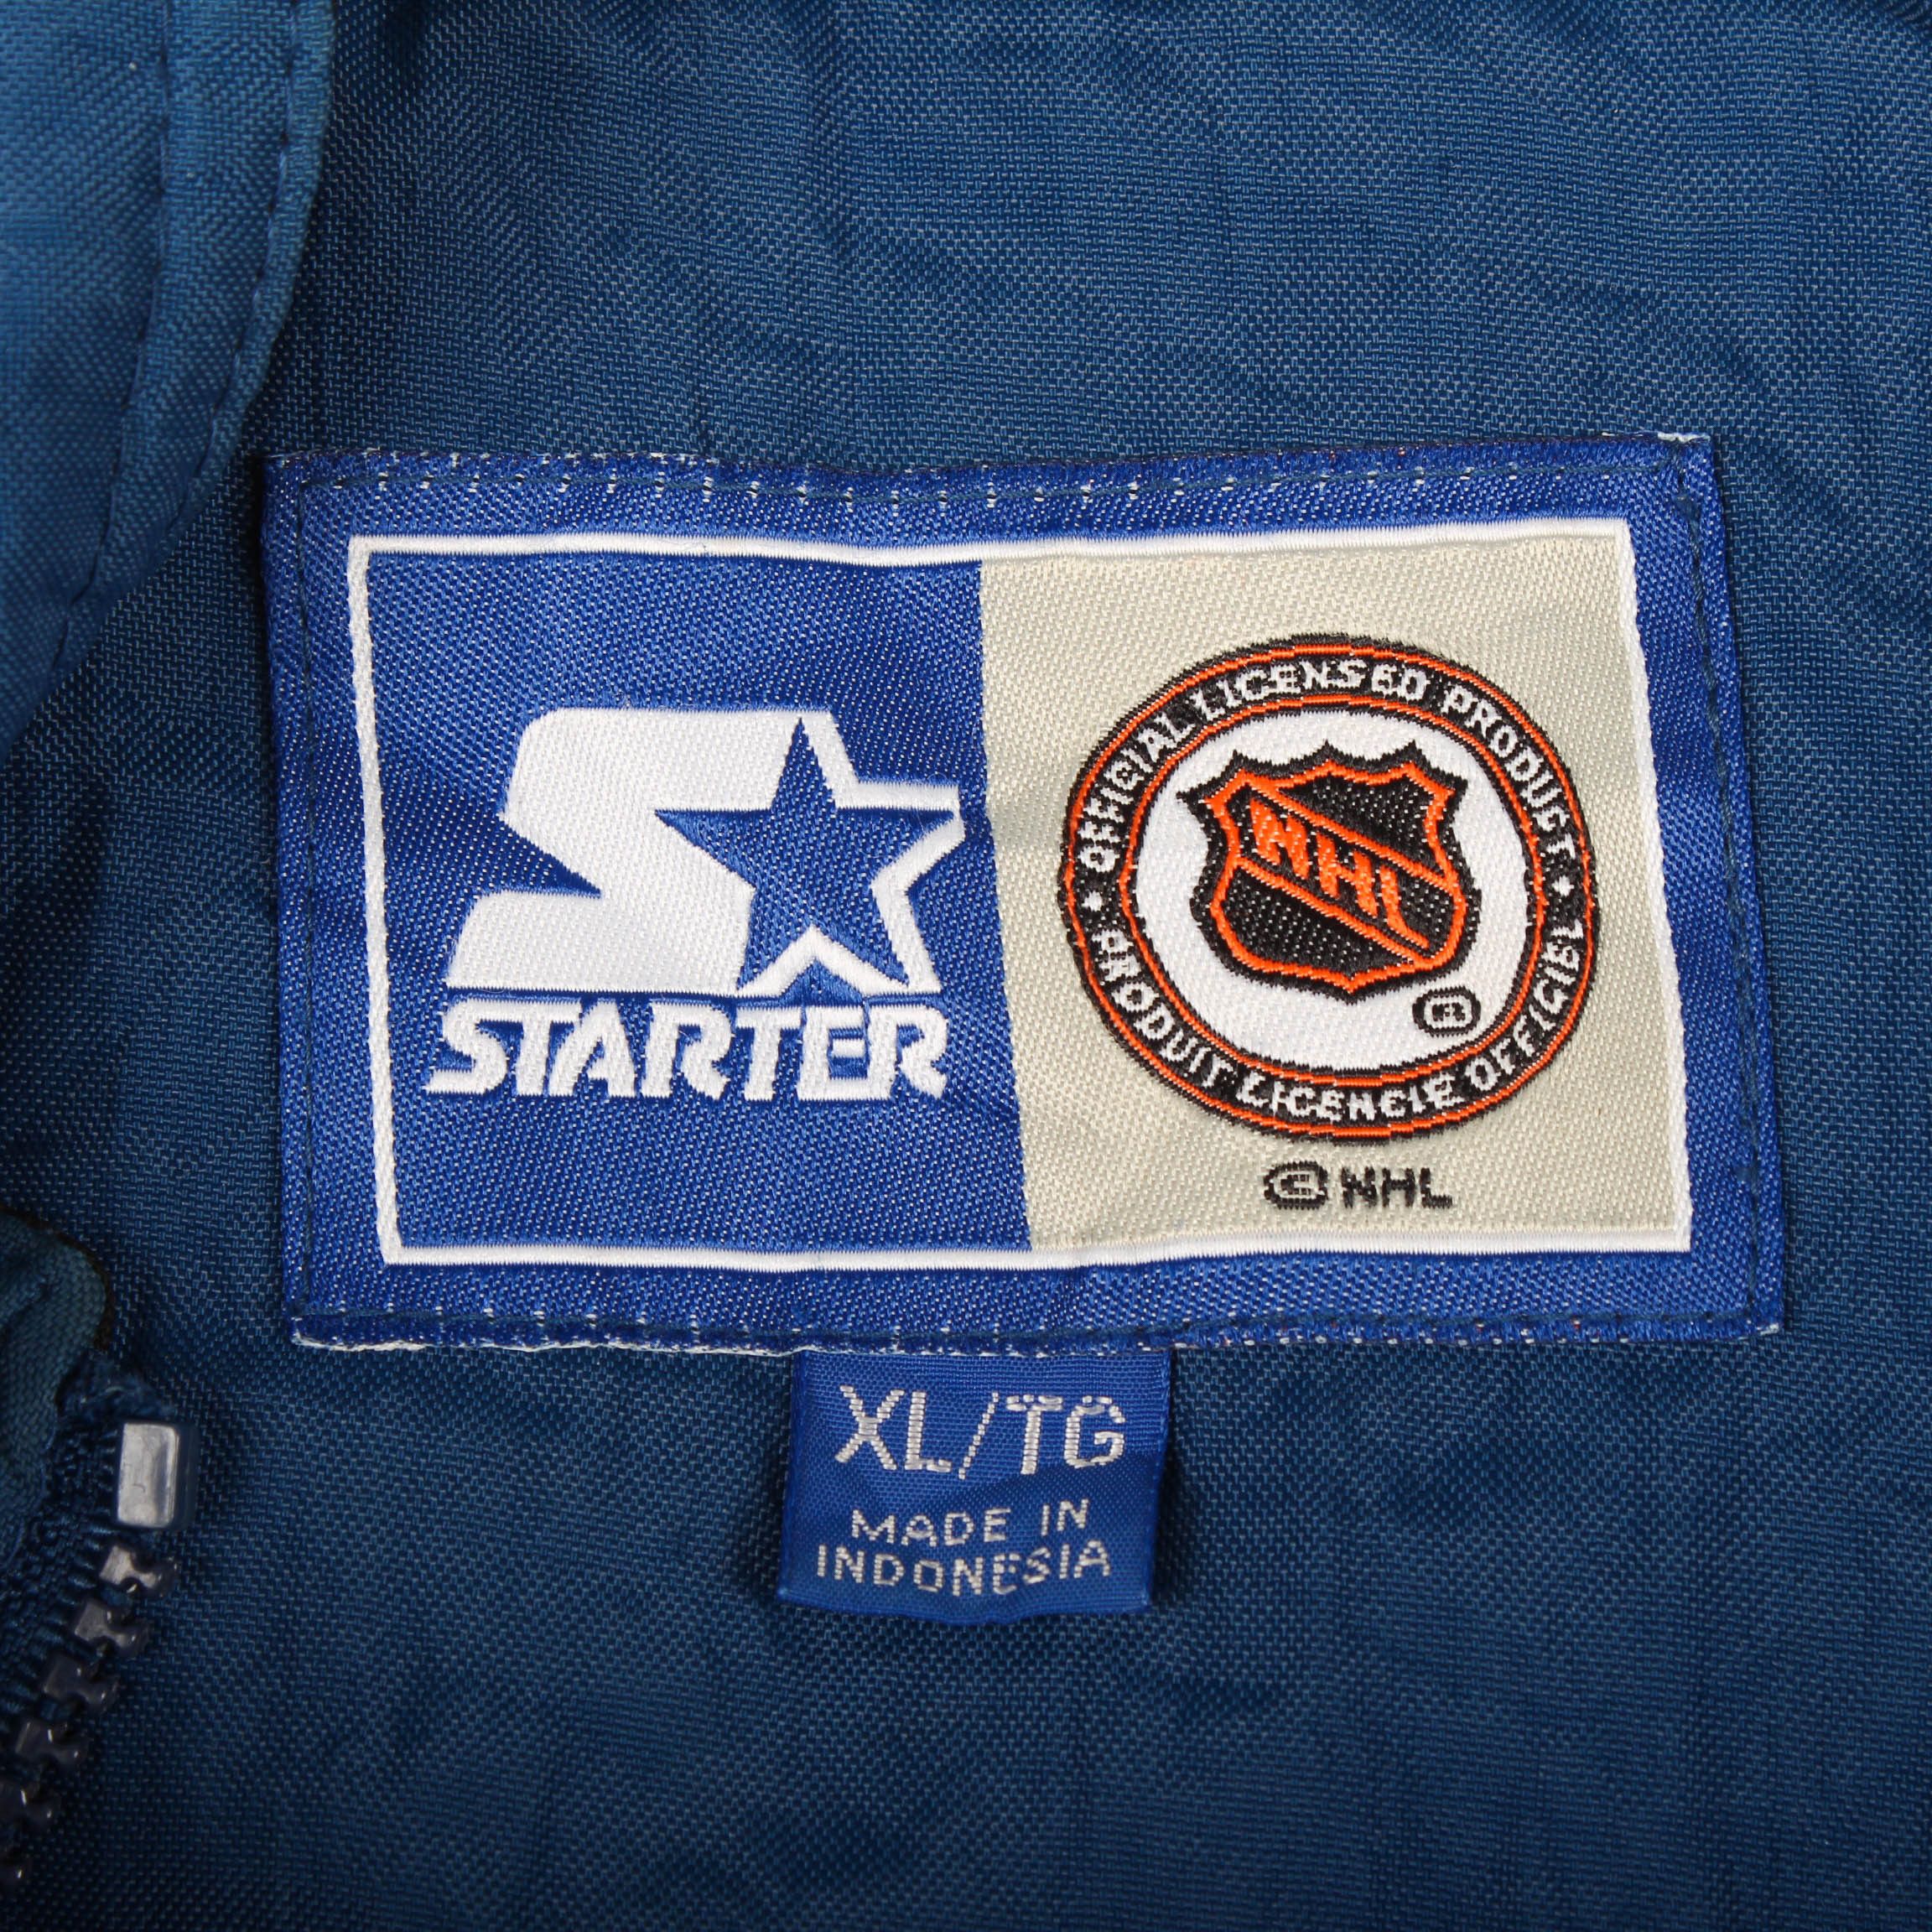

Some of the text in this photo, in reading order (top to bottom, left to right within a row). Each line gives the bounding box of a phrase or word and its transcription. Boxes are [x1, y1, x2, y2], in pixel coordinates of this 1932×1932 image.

[1078, 659, 1578, 872] OFFICIAL LICENSED PRODUCT
[1249, 797, 1429, 950] NHL
[423, 998, 949, 1100] STARTER
[1093, 921, 1584, 1122] PRODUIT LICENCIE OFFICIEL
[834, 1384, 1126, 1479] XL/TG
[817, 1540, 1111, 1597] INDONESIA
[851, 1498, 1089, 1547] MADE IN
